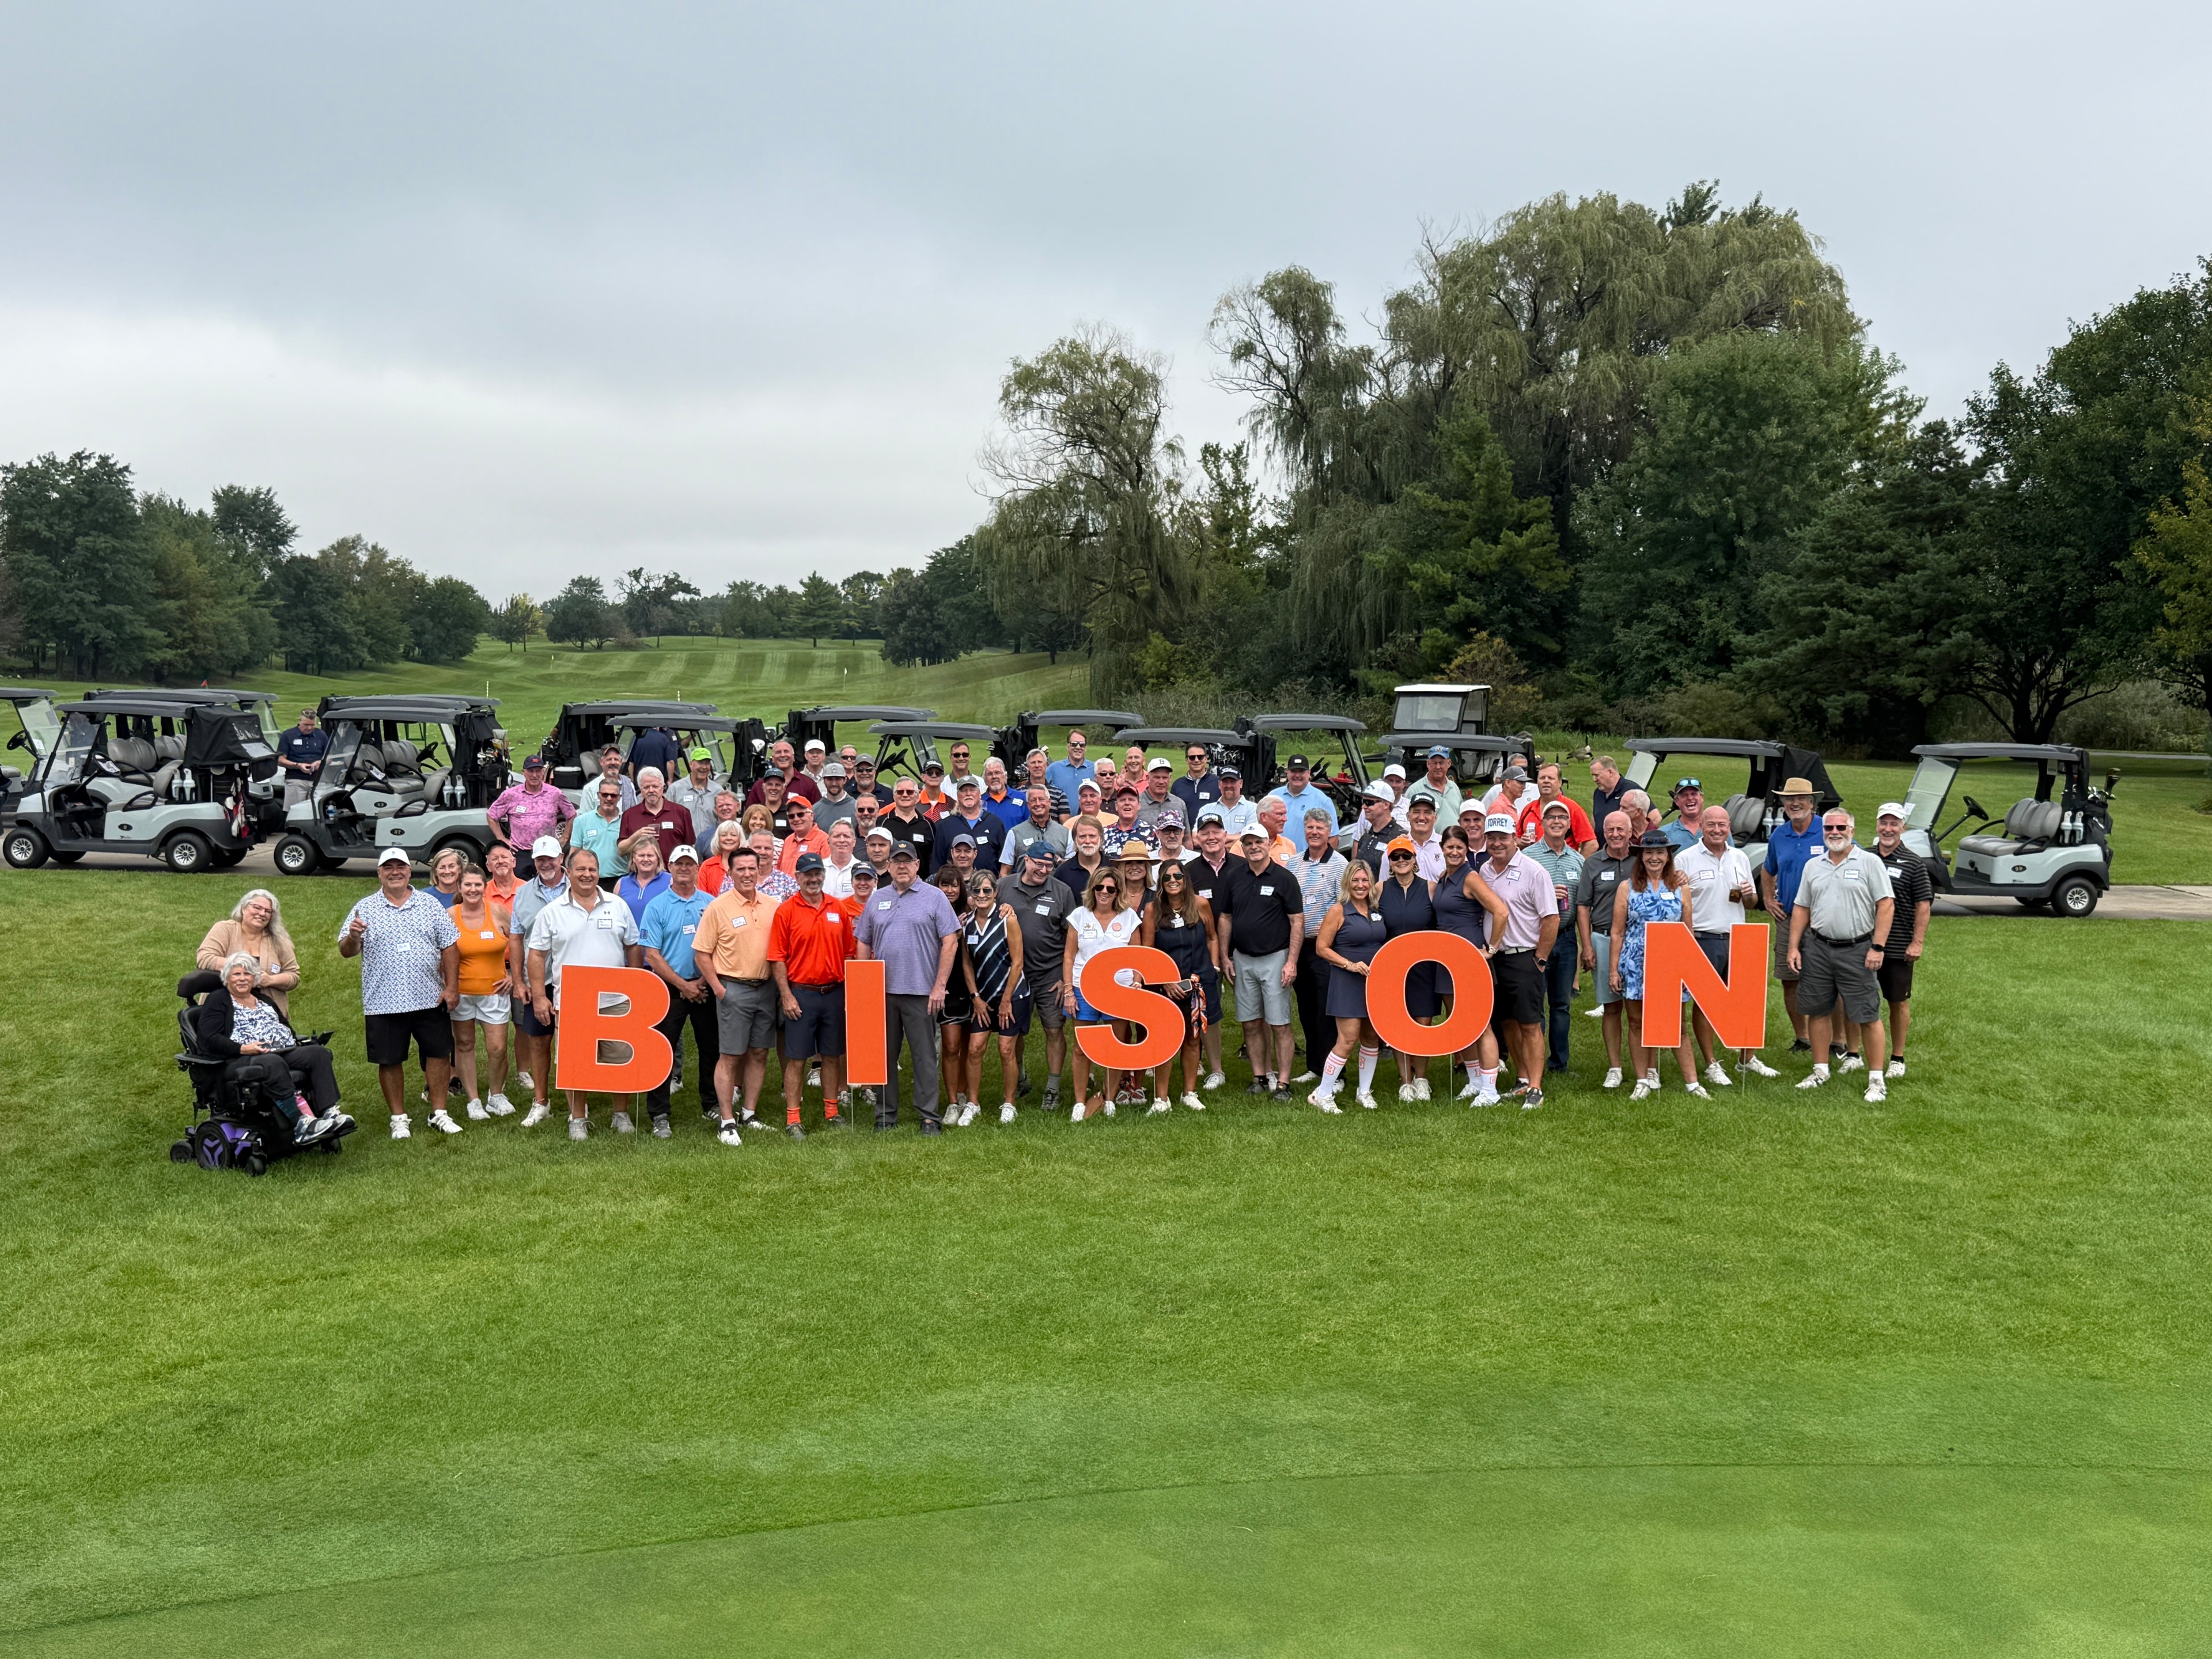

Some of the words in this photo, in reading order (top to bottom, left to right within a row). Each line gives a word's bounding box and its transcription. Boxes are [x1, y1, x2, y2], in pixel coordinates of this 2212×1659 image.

[1487, 817, 1508, 827] TORREY
[556, 964, 673, 1093] B
[844, 960, 888, 1085] I
[1075, 945, 1185, 1070] S
[1365, 930, 1494, 1056] O
[1641, 921, 1770, 1048] N
[1325, 1061, 1336, 1075] B
